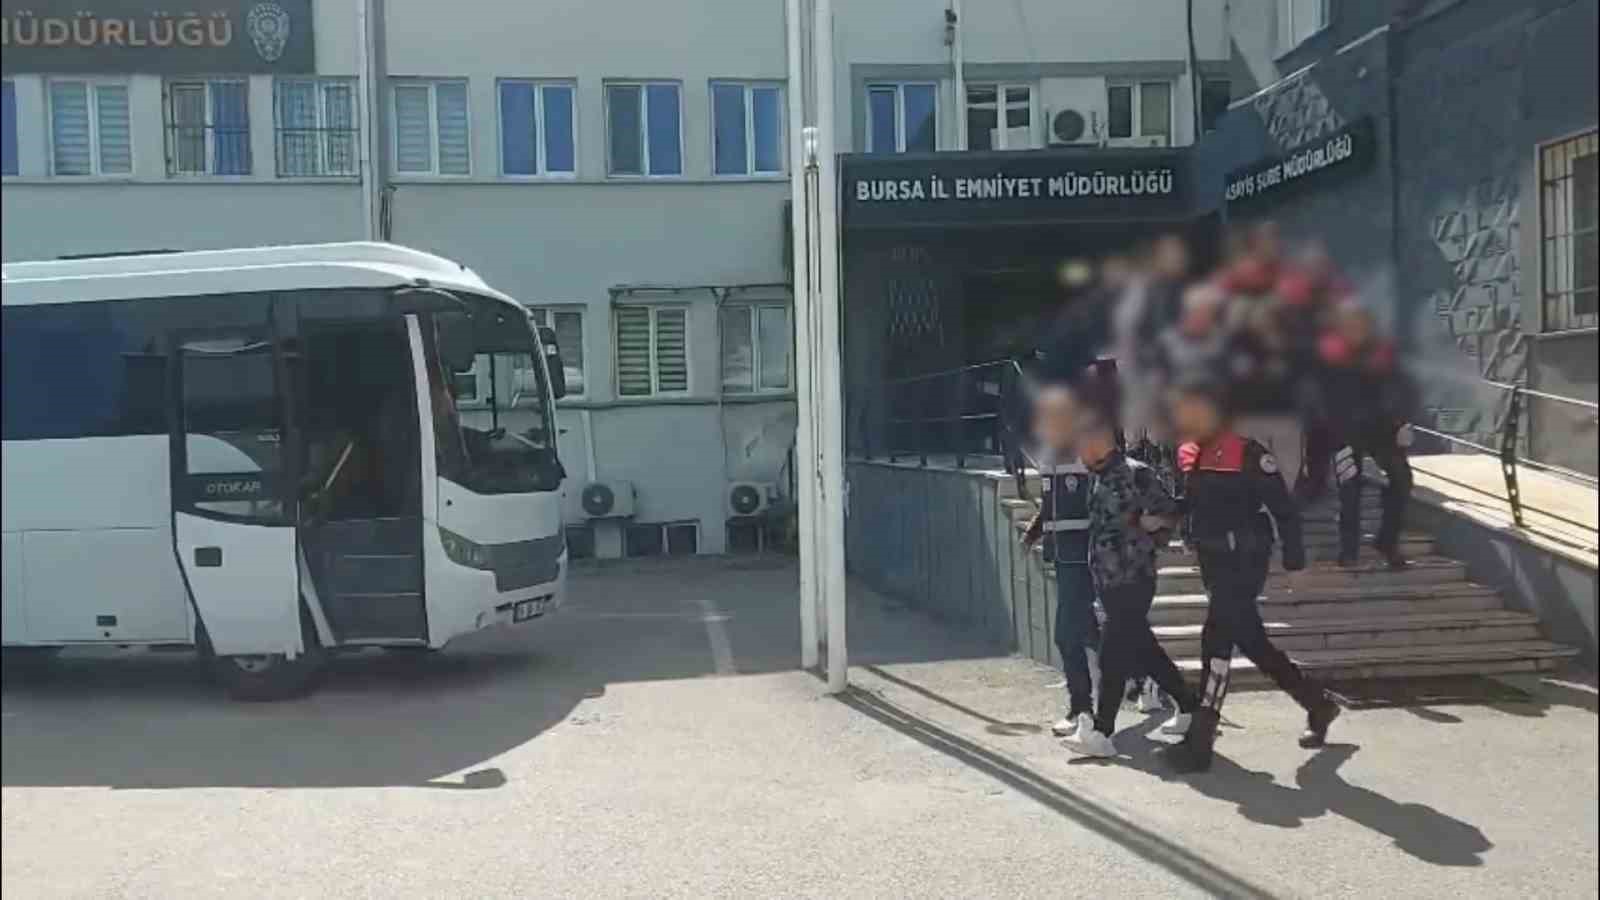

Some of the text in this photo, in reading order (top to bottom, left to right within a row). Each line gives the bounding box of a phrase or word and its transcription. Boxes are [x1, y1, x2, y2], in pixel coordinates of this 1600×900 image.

[856, 169, 1173, 201] BURSA İL EMNİYET MÜDÜRLÜĞÜ
